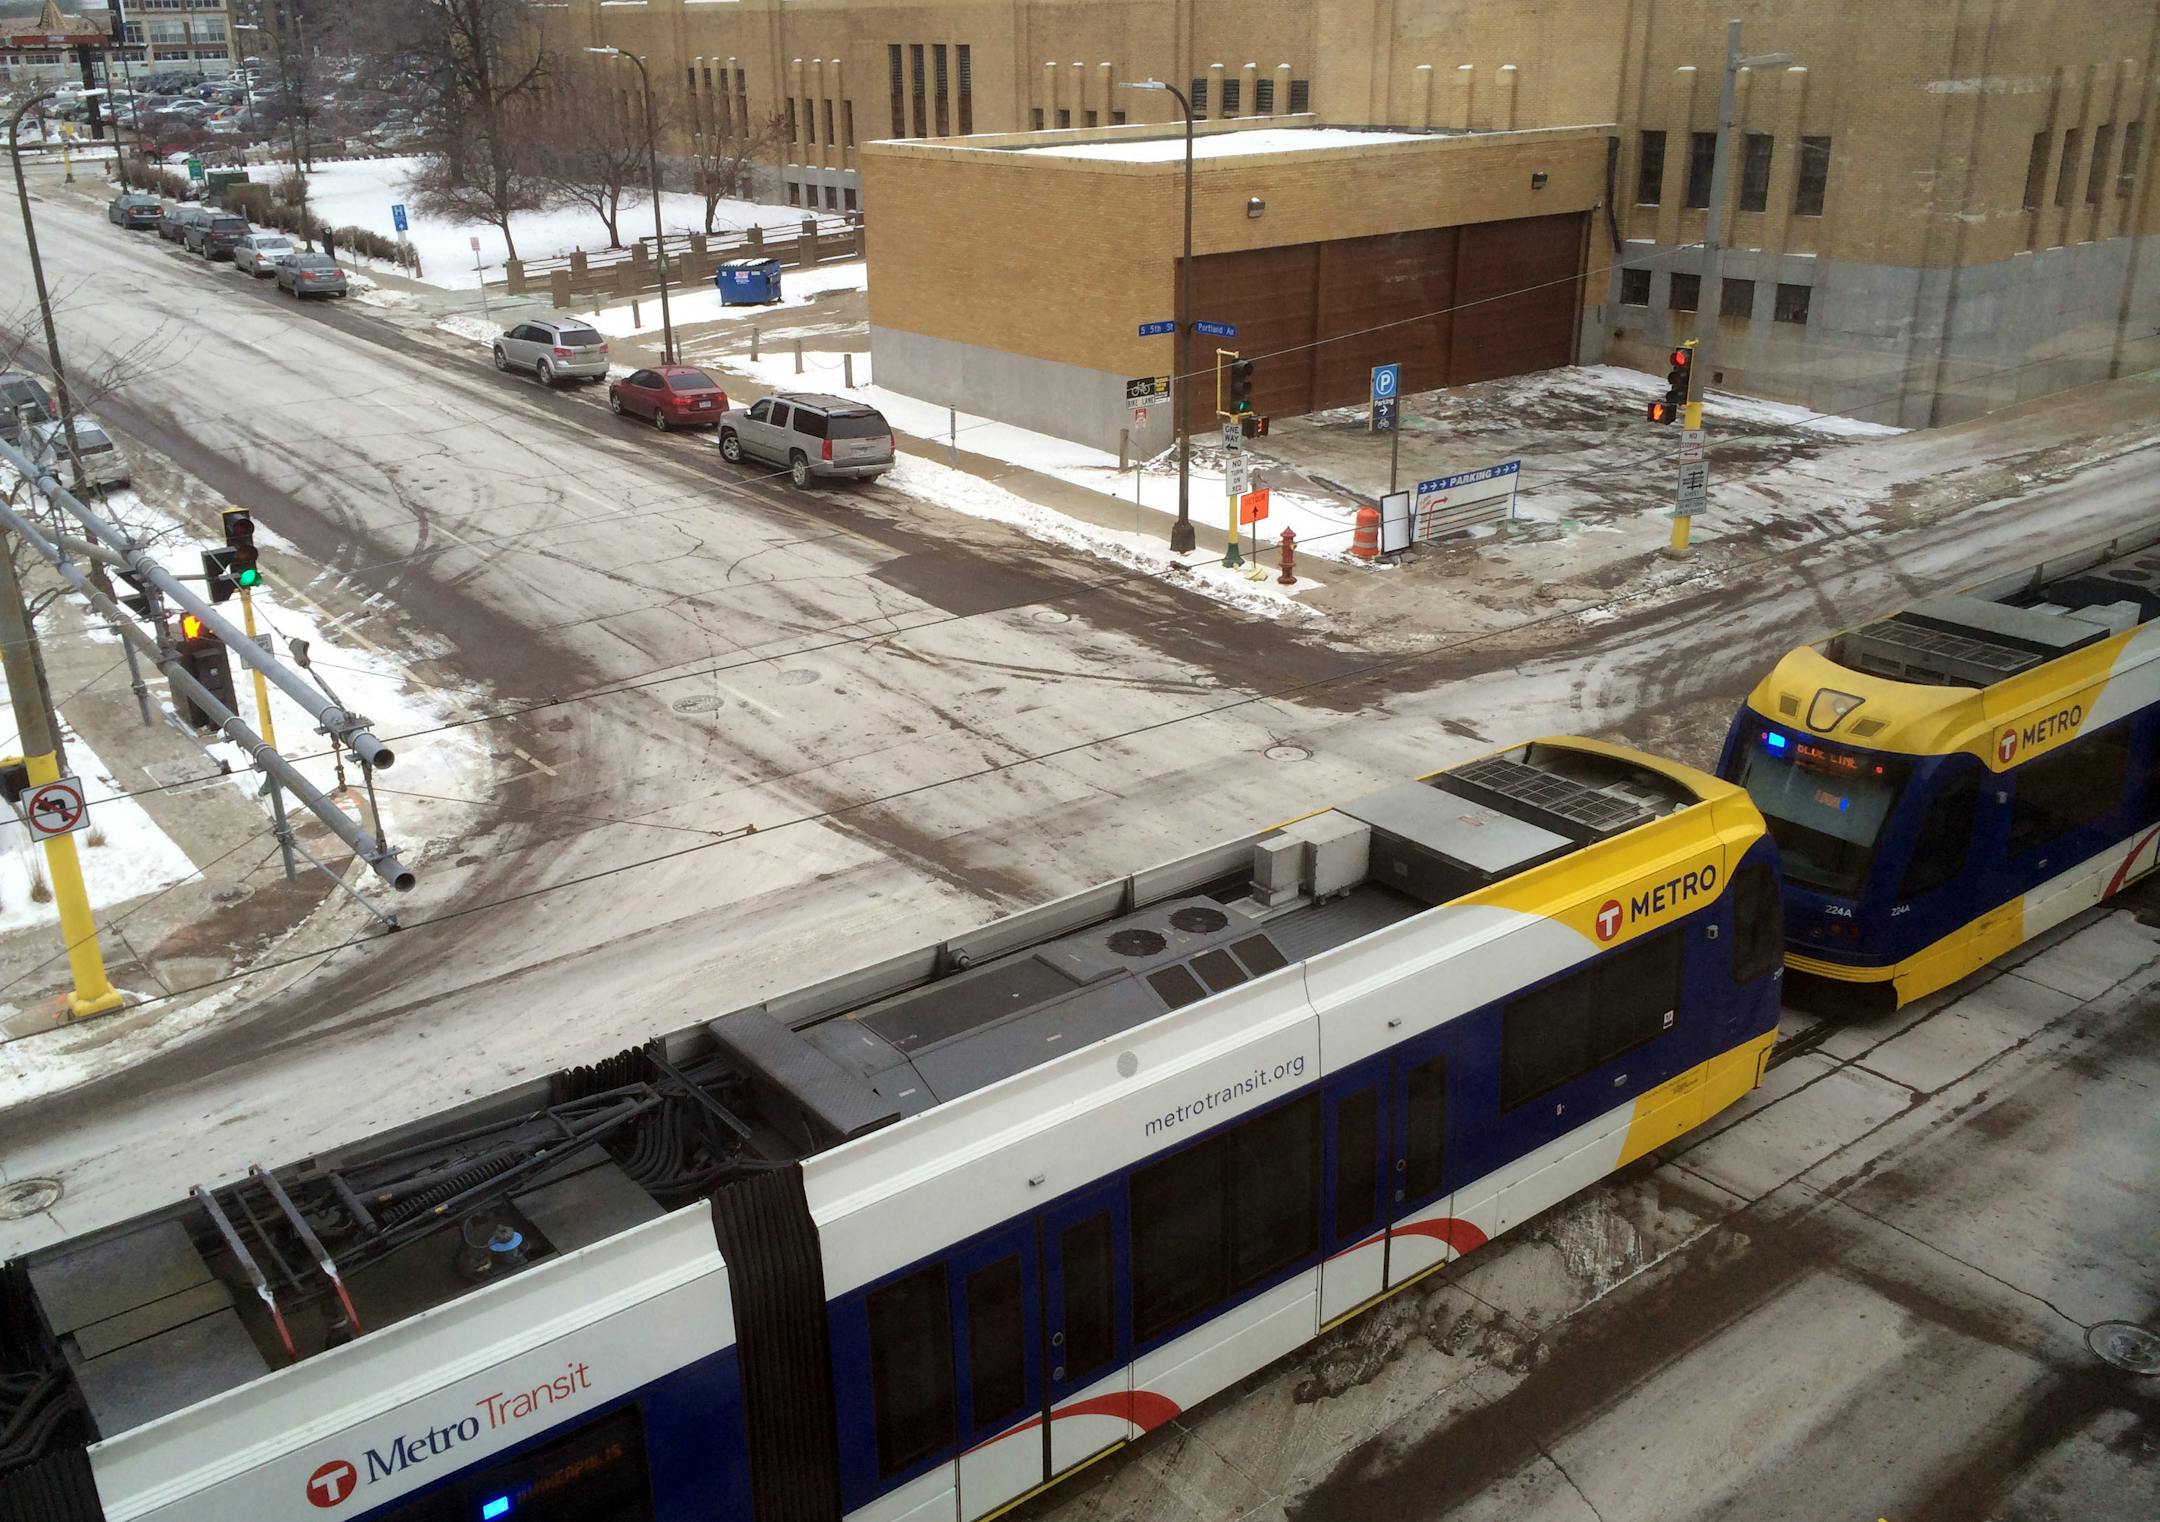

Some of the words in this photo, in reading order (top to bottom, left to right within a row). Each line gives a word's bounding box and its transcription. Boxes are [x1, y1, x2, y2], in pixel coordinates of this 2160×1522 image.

[1150, 324, 1162, 332] 5th
[1166, 323, 1174, 331] St
[1198, 321, 1223, 334] Portland
[1381, 374, 1391, 391] P
[1374, 398, 1394, 407] Parking
[1224, 425, 1239, 434] ONE
[1224, 434, 1240, 443] WAY
[1232, 460, 1241, 468] NO
[1230, 469, 1244, 477] TURN
[1449, 470, 1492, 487] PARKING
[2022, 705, 2082, 749] METRO
[1631, 864, 1716, 923] METRO
[1824, 904, 1852, 918] 224A
[1890, 904, 1911, 916] 224A
[1145, 1055, 1304, 1136] metrotransit.org
